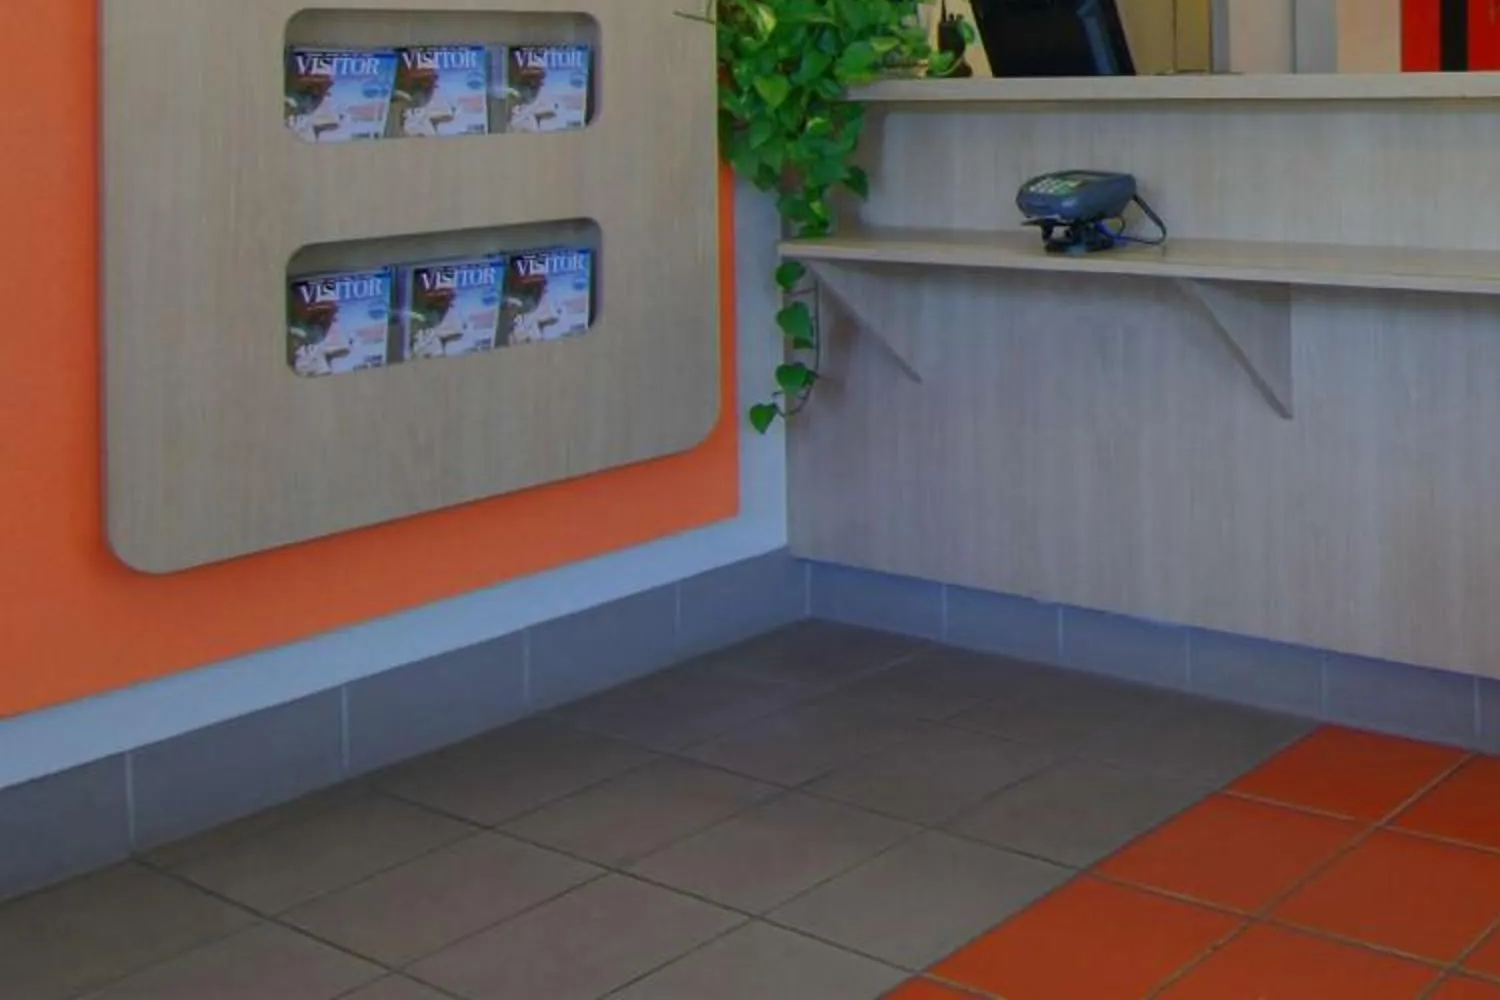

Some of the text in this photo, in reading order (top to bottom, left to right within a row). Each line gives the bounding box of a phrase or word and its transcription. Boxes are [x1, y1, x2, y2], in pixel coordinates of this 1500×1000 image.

[296, 53, 381, 77] VISITOR
[402, 48, 478, 70] VISITOR
[513, 47, 584, 70] VISITOR
[516, 252, 586, 278] VISITOR
[301, 277, 384, 304] VISITOR
[421, 265, 497, 292] VISITOR
